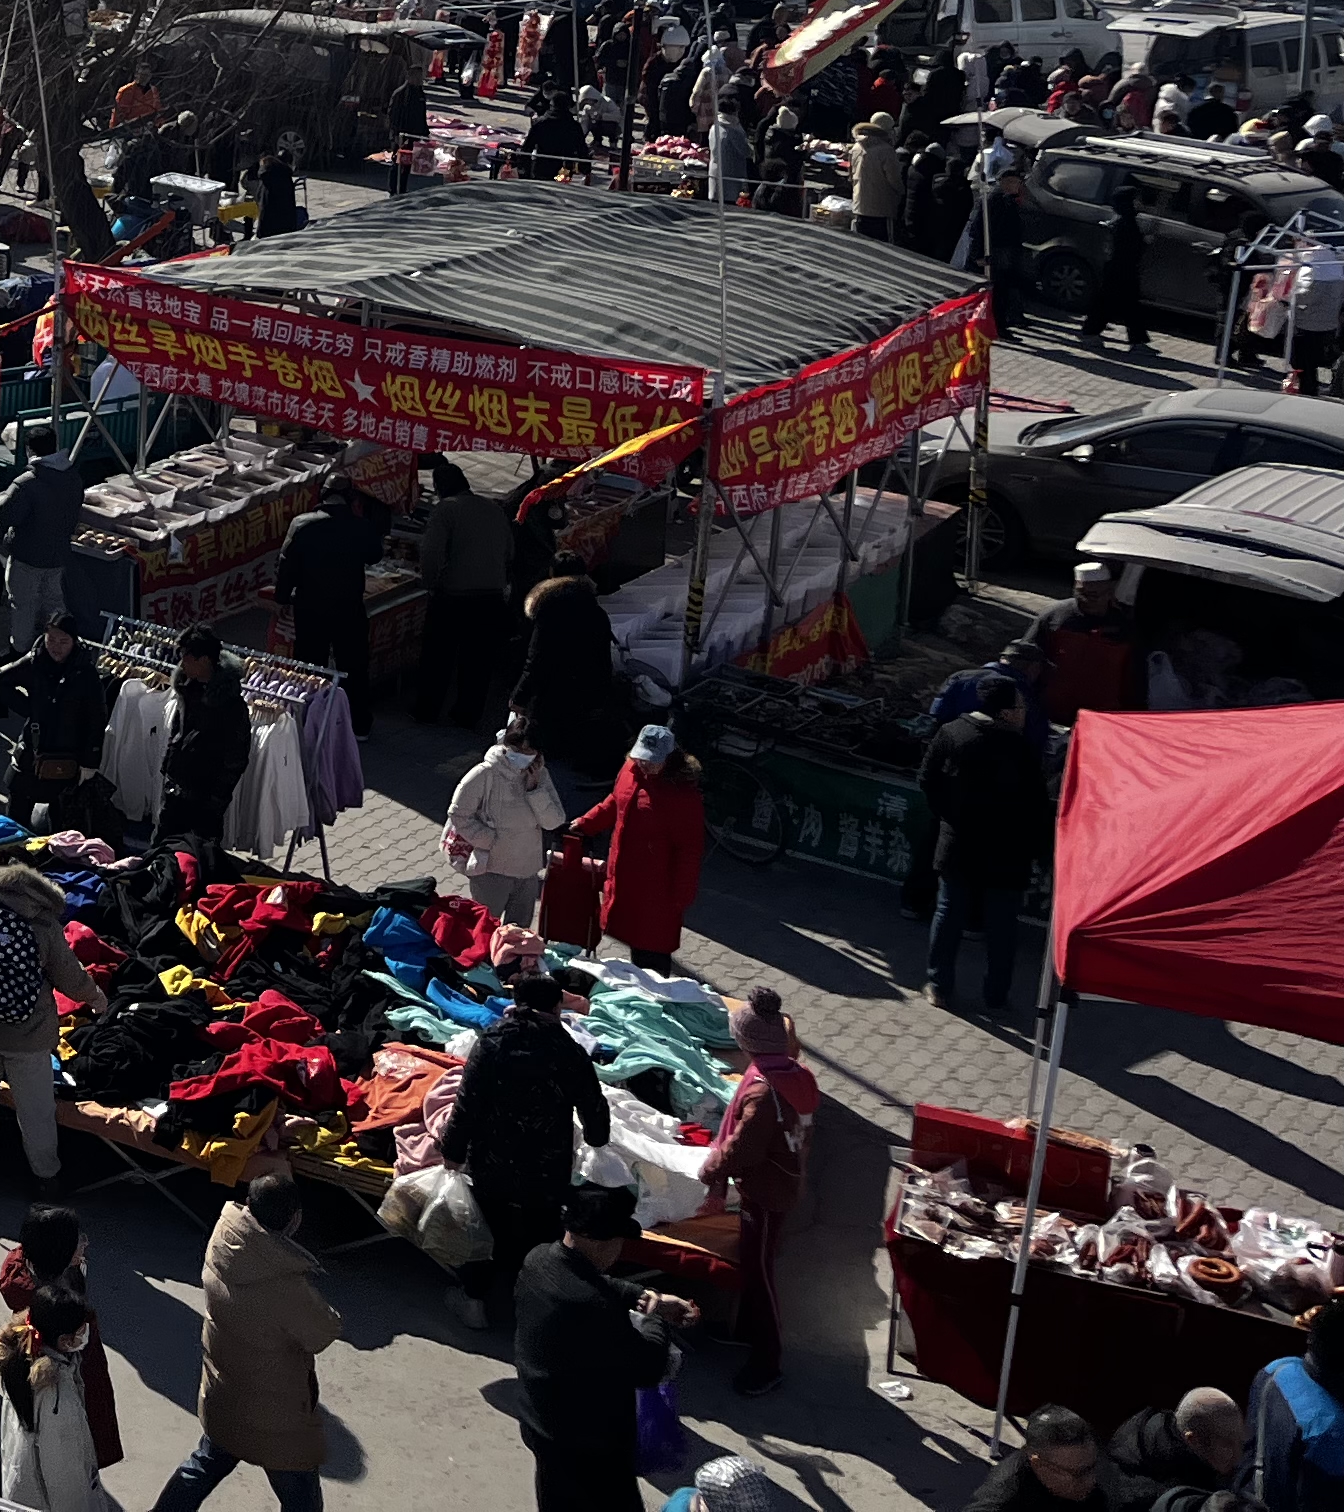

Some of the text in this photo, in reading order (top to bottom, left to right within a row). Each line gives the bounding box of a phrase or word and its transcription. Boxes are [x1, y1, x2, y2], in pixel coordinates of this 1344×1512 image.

[211, 307, 354, 358] 品一根回味无穷
[363, 337, 518, 383] 只戒香精助燃剂
[526, 360, 694, 402] 不戒口感味天成
[342, 407, 429, 452] 多地点销售
